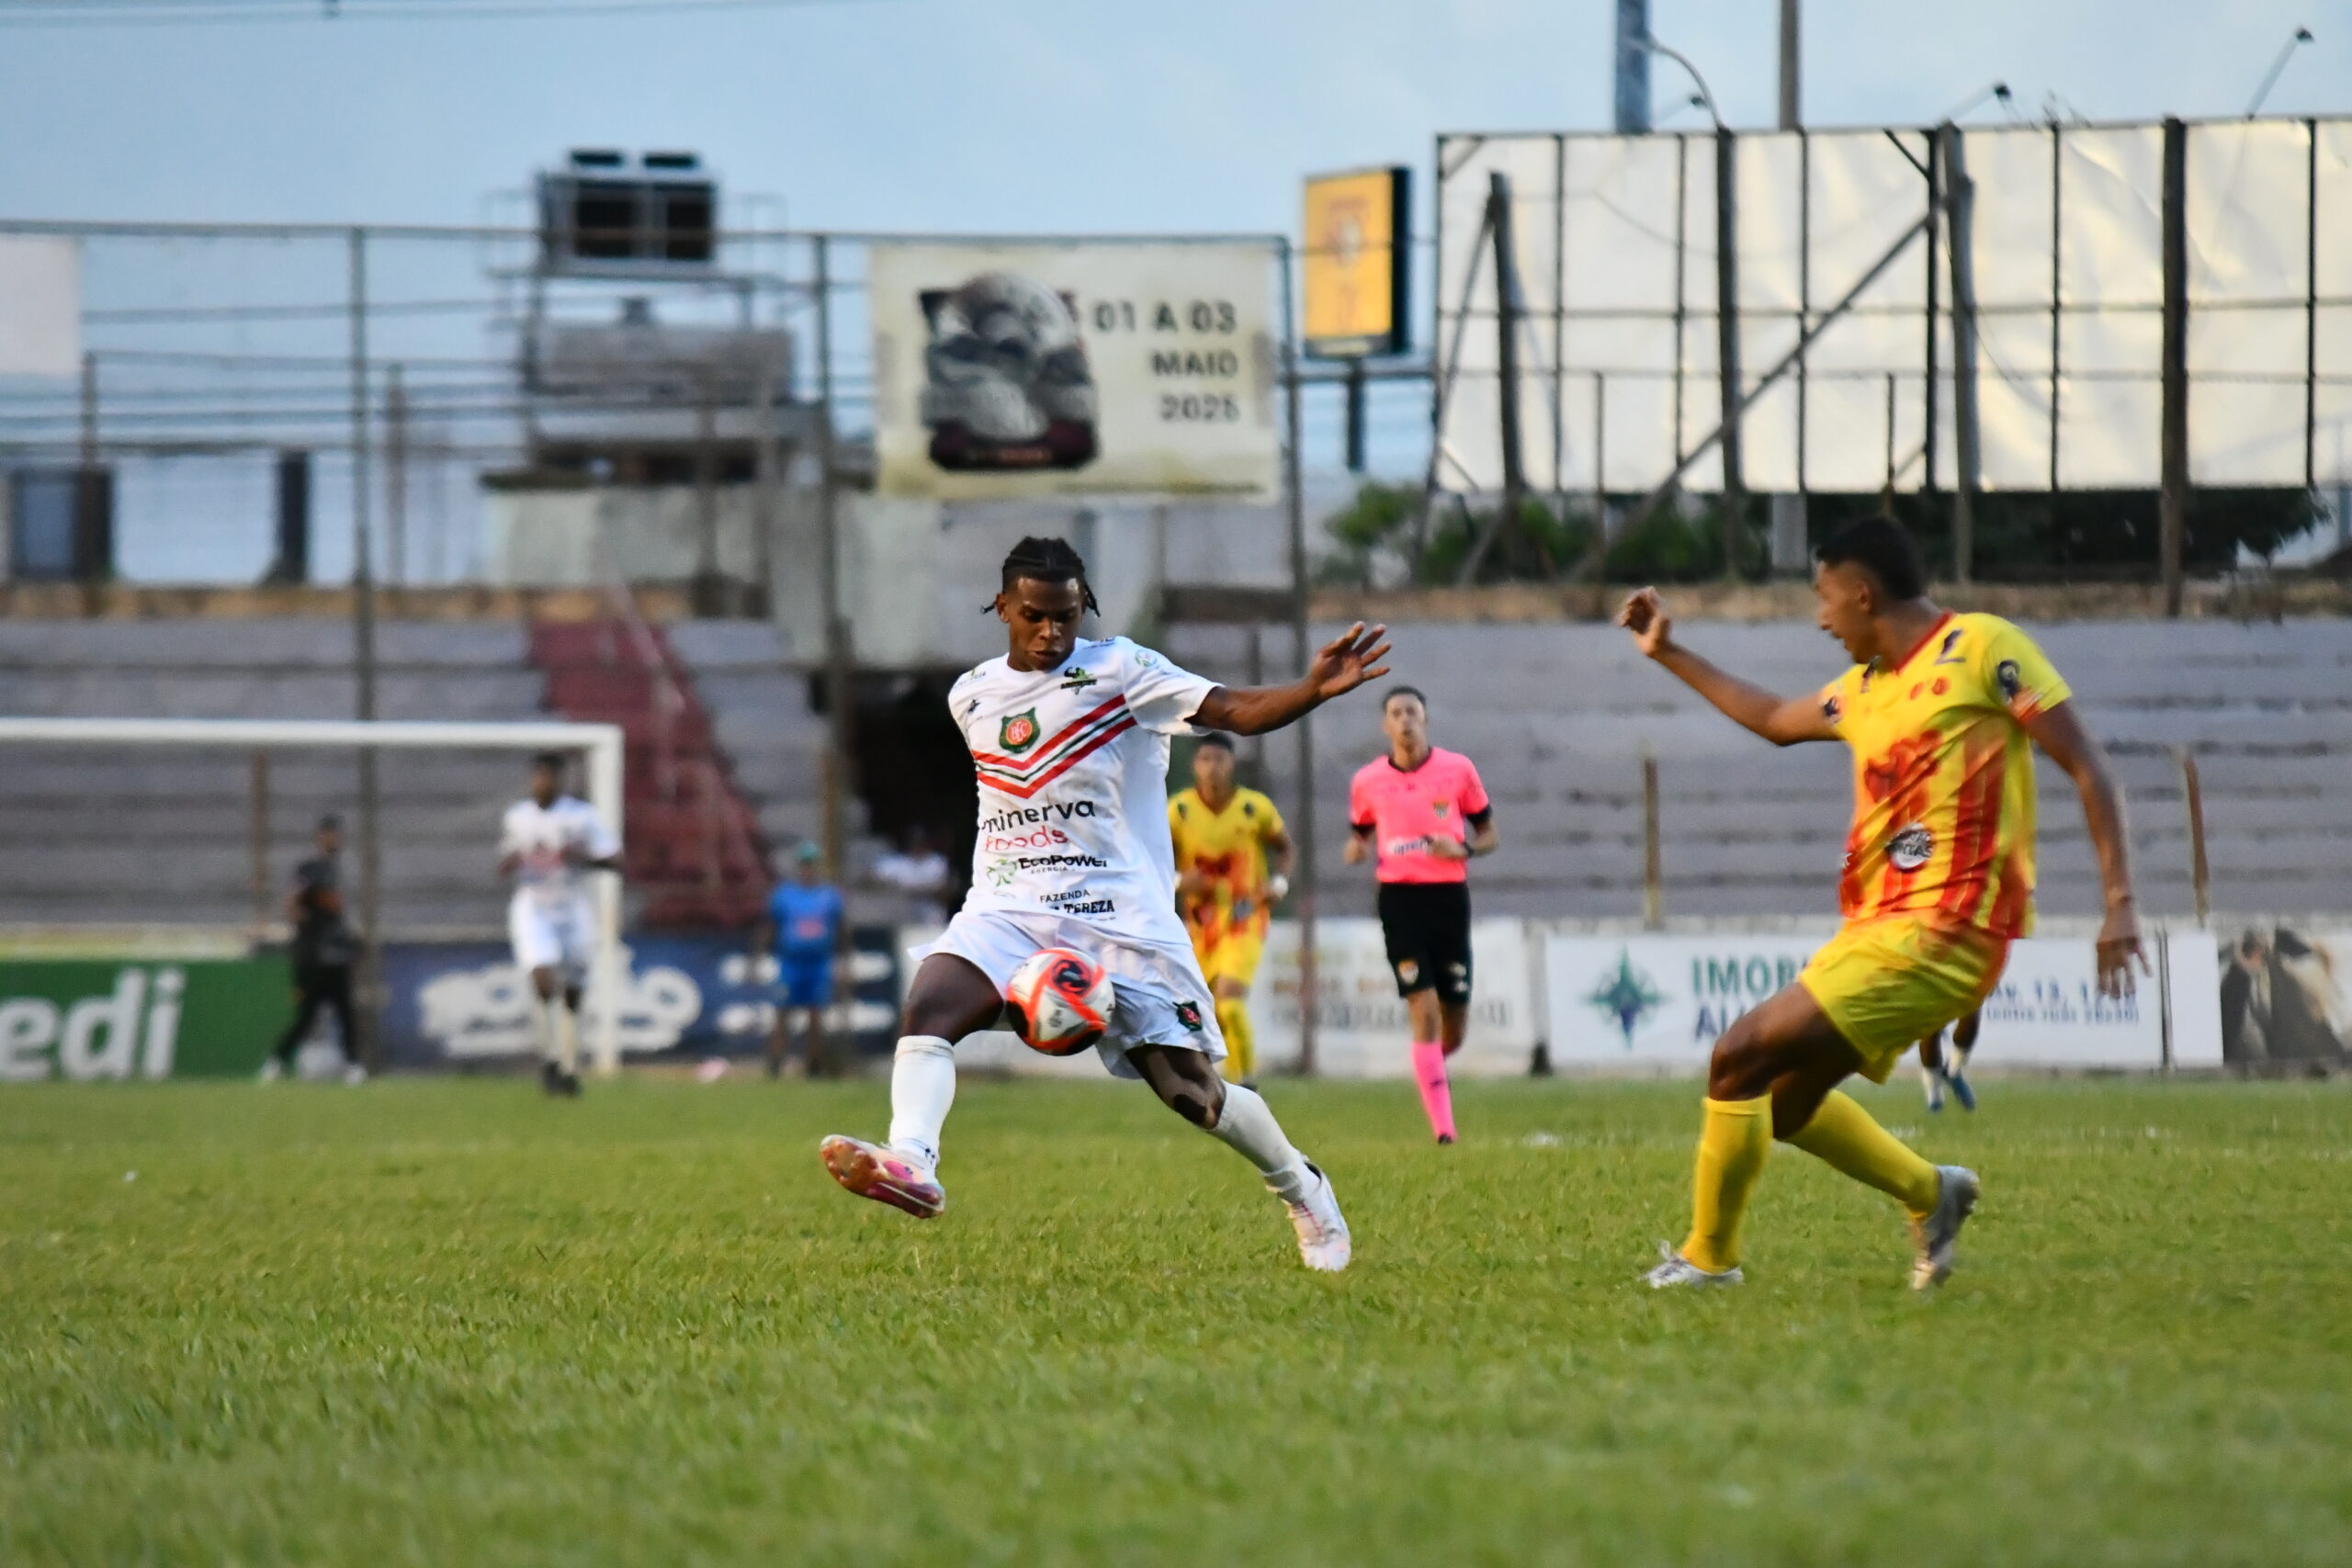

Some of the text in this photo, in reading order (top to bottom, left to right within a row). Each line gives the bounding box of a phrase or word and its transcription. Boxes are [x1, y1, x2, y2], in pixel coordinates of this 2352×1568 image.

[1093, 299, 1238, 335] 01 A 03
[1151, 349, 1239, 378] MAIO
[1159, 393, 1240, 422] 2025
[982, 800, 1096, 833] minerva
[985, 825, 1069, 852] foods
[1039, 888, 1091, 903] FAZENDA
[1063, 899, 1115, 914] TEREZA
